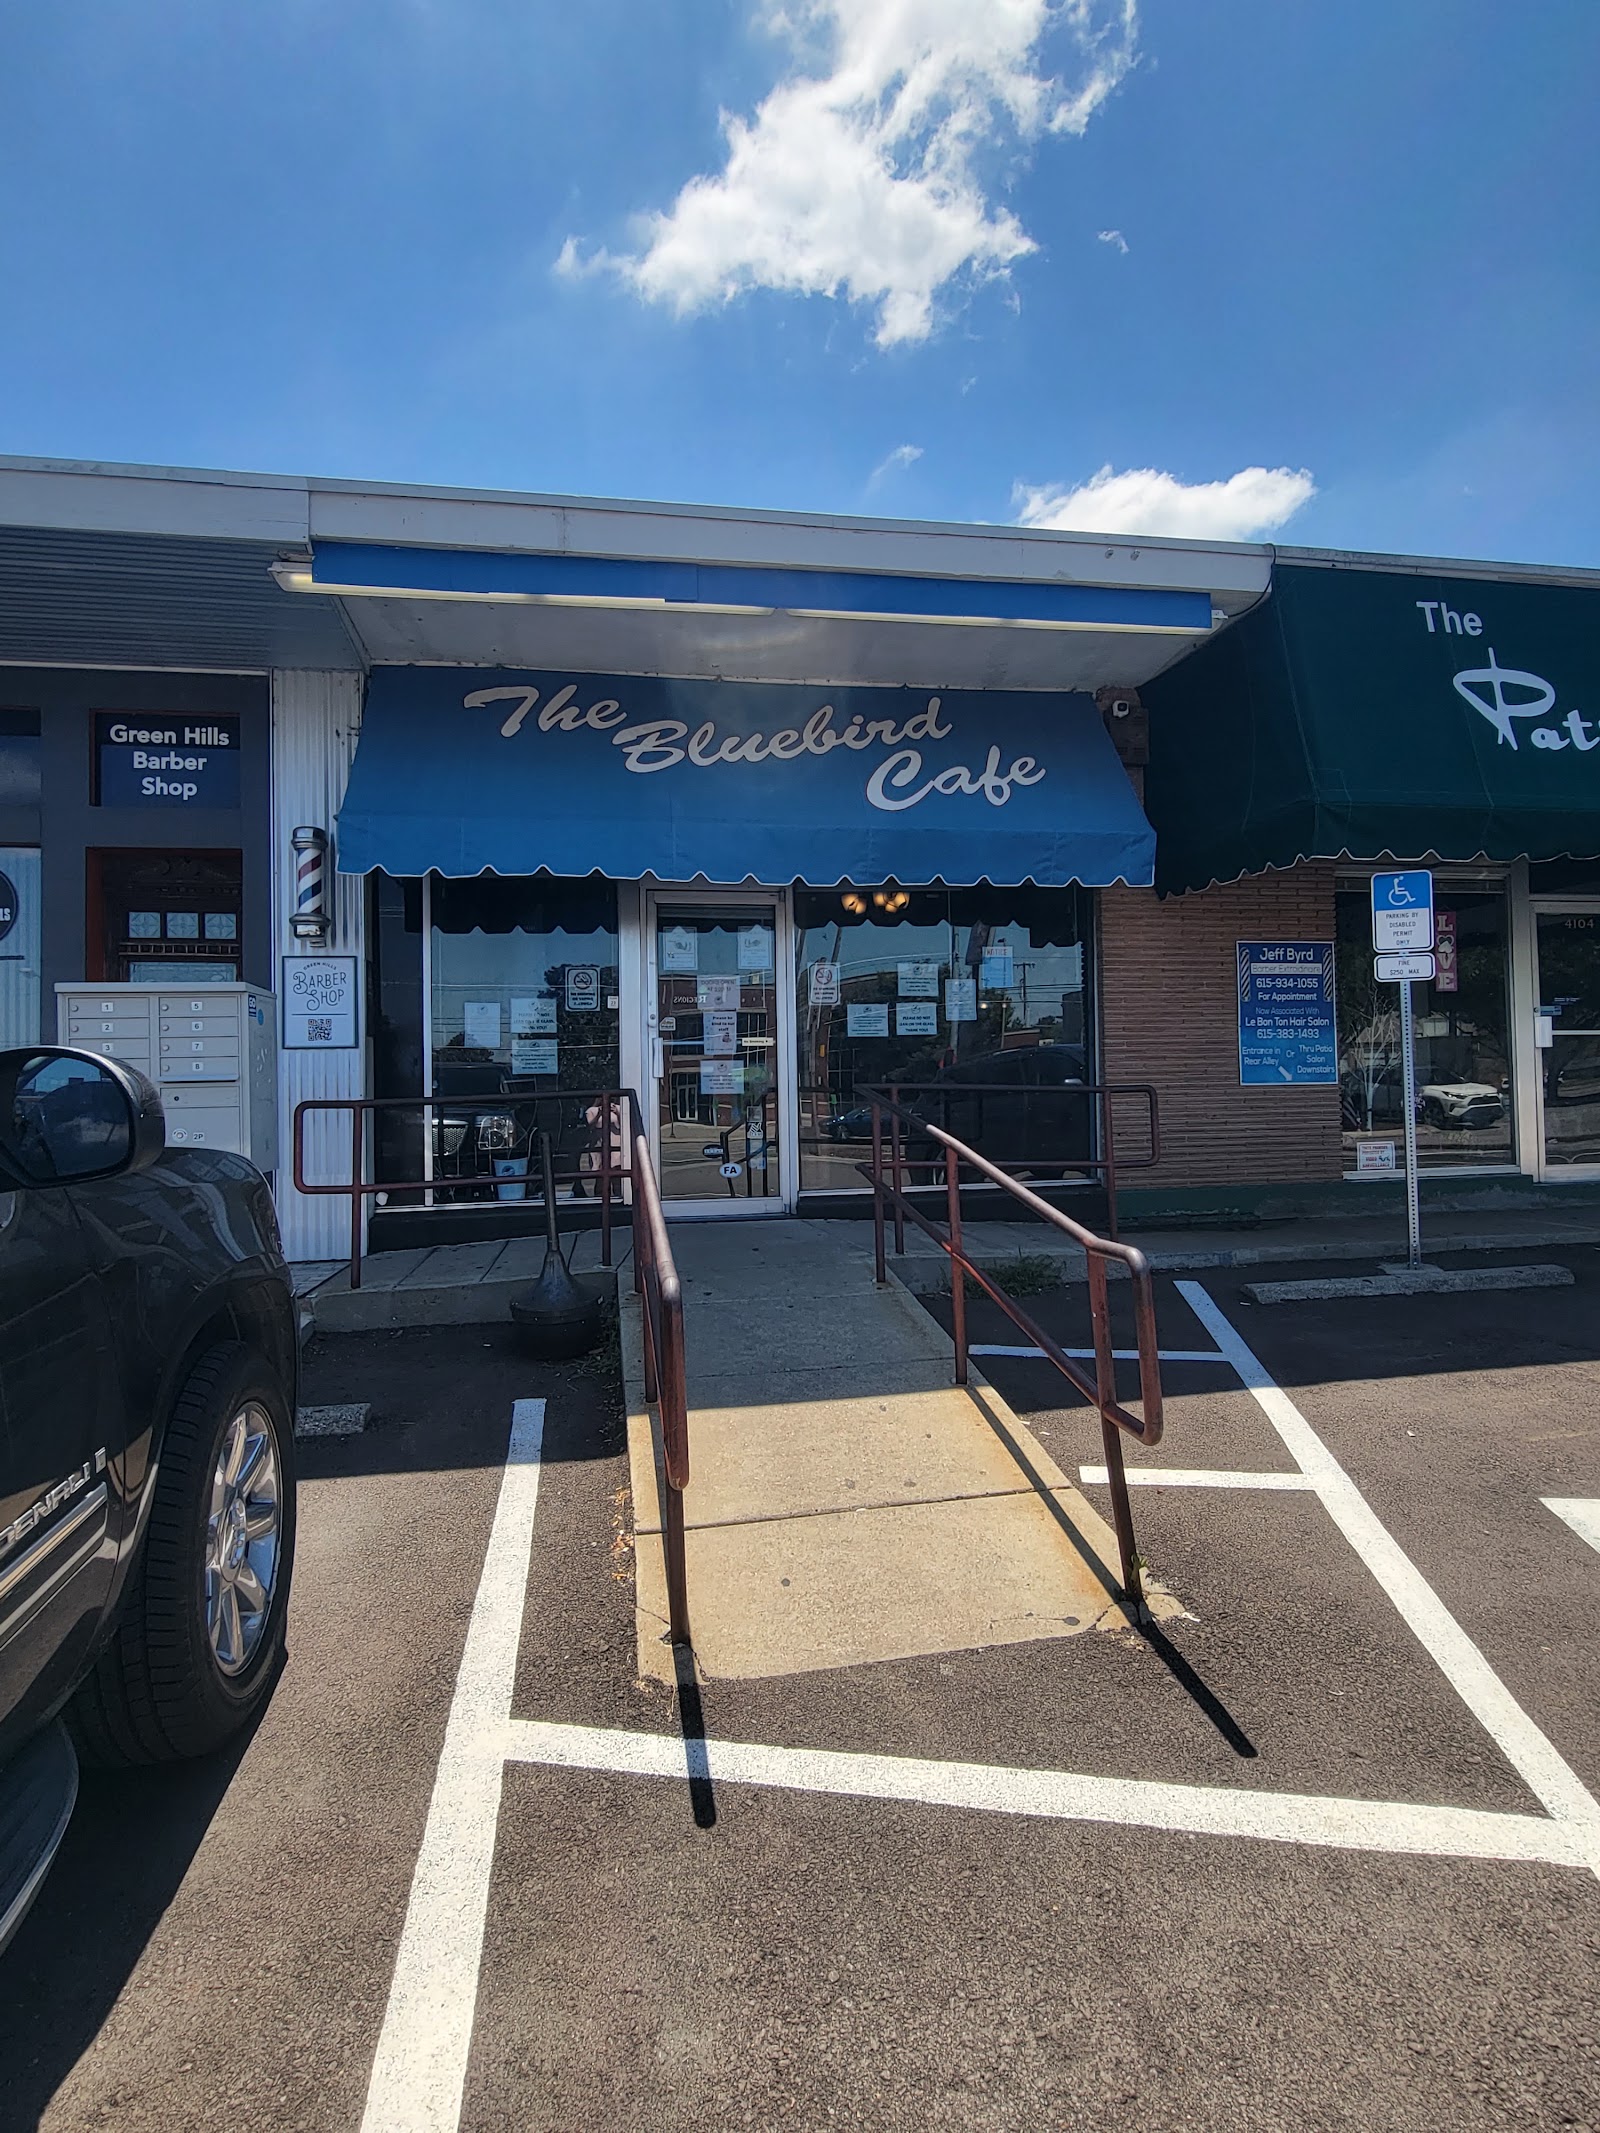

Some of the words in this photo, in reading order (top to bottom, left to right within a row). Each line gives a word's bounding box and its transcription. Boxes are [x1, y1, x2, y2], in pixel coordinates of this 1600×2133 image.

[1416, 601, 1483, 636] The
[1453, 647, 1600, 750] Pat
[464, 684, 627, 738] The
[612, 697, 952, 773] Bluebird
[109, 724, 177, 744] Green
[184, 726, 230, 746] Hills
[133, 751, 208, 770] Barber
[867, 745, 1046, 811] Cafe
[141, 776, 198, 800] Shop
[1564, 918, 1595, 929] 4104
[1259, 948, 1285, 961] Jeff
[1286, 948, 1314, 964] Byrd
[303, 962, 320, 970] GREEN
[322, 962, 337, 970] HILLS
[1252, 965, 1277, 973] Barber
[292, 971, 347, 995] BARBER
[1256, 978, 1319, 988] 615-934-1055
[306, 989, 345, 1011] SHOP
[1258, 992, 1271, 1000] For
[1271, 992, 1317, 1002] Appointment
[1270, 1007, 1304, 1015] Associated
[1245, 1017, 1256, 1026] Le
[1257, 1017, 1273, 1026] Bon
[1274, 1017, 1288, 1026] Ton
[1289, 1017, 1306, 1026] Hair
[1307, 1016, 1330, 1026] Salon
[1256, 1029, 1320, 1039] 615-383-1493
[1242, 1046, 1273, 1055] Entrance
[1274, 1046, 1281, 1054] in
[1299, 1044, 1314, 1052] Thru
[1315, 1045, 1333, 1053] Patio
[1285, 1050, 1295, 1058] Or
[1306, 1055, 1326, 1063] Salon
[1244, 1057, 1261, 1065] Rear
[1262, 1057, 1279, 1066] Alley
[1296, 1065, 1335, 1074] Downstairs
[724, 1166, 738, 1174] FA
[0, 1447, 106, 1554] DENALI
